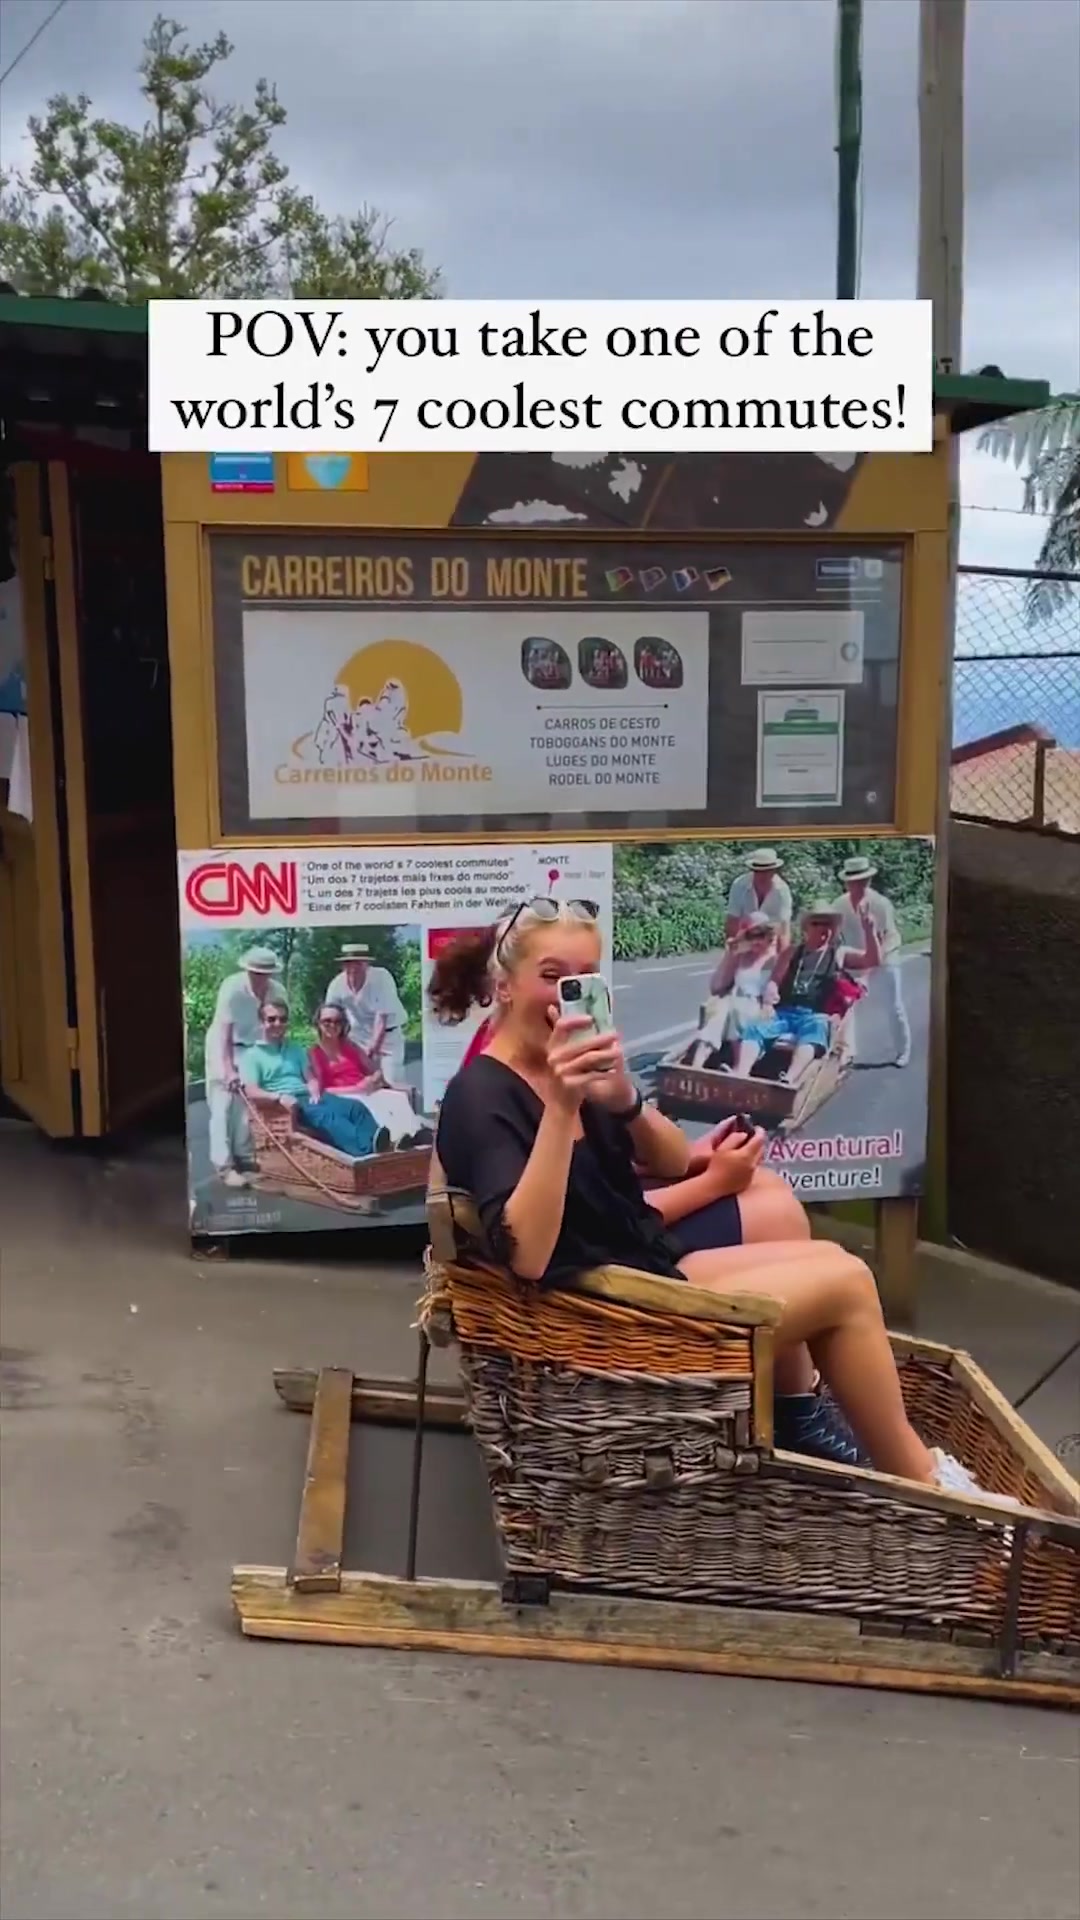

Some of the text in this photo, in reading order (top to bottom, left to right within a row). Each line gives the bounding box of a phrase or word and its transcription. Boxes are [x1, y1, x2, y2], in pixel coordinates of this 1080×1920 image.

[242, 555, 588, 597] CARREIROS DO MONTE
[545, 717, 660, 730] CARROS DE CESTO
[530, 735, 676, 749] TOBOGGANS DO MONTE
[546, 754, 656, 767] LUGES DO MONTE
[274, 762, 493, 784] Carreiros do Monte
[549, 772, 660, 786] RODEL DO MONTE
[331, 861, 342, 870] of
[345, 861, 362, 870] the
[415, 859, 453, 868] coolest
[328, 875, 348, 884] dos
[360, 874, 399, 885] trajetos
[402, 873, 426, 882] mais
[185, 861, 298, 917] CNN
[335, 889, 353, 897] des
[366, 888, 398, 898] trajets
[401, 887, 416, 896] les
[444, 886, 472, 895] cools
[335, 902, 351, 911] der
[411, 900, 450, 909] Fahrten
[453, 900, 463, 908] in
[465, 899, 482, 908] der
[769, 1131, 901, 1160] Aventura!
[783, 1167, 880, 1189] venture!
